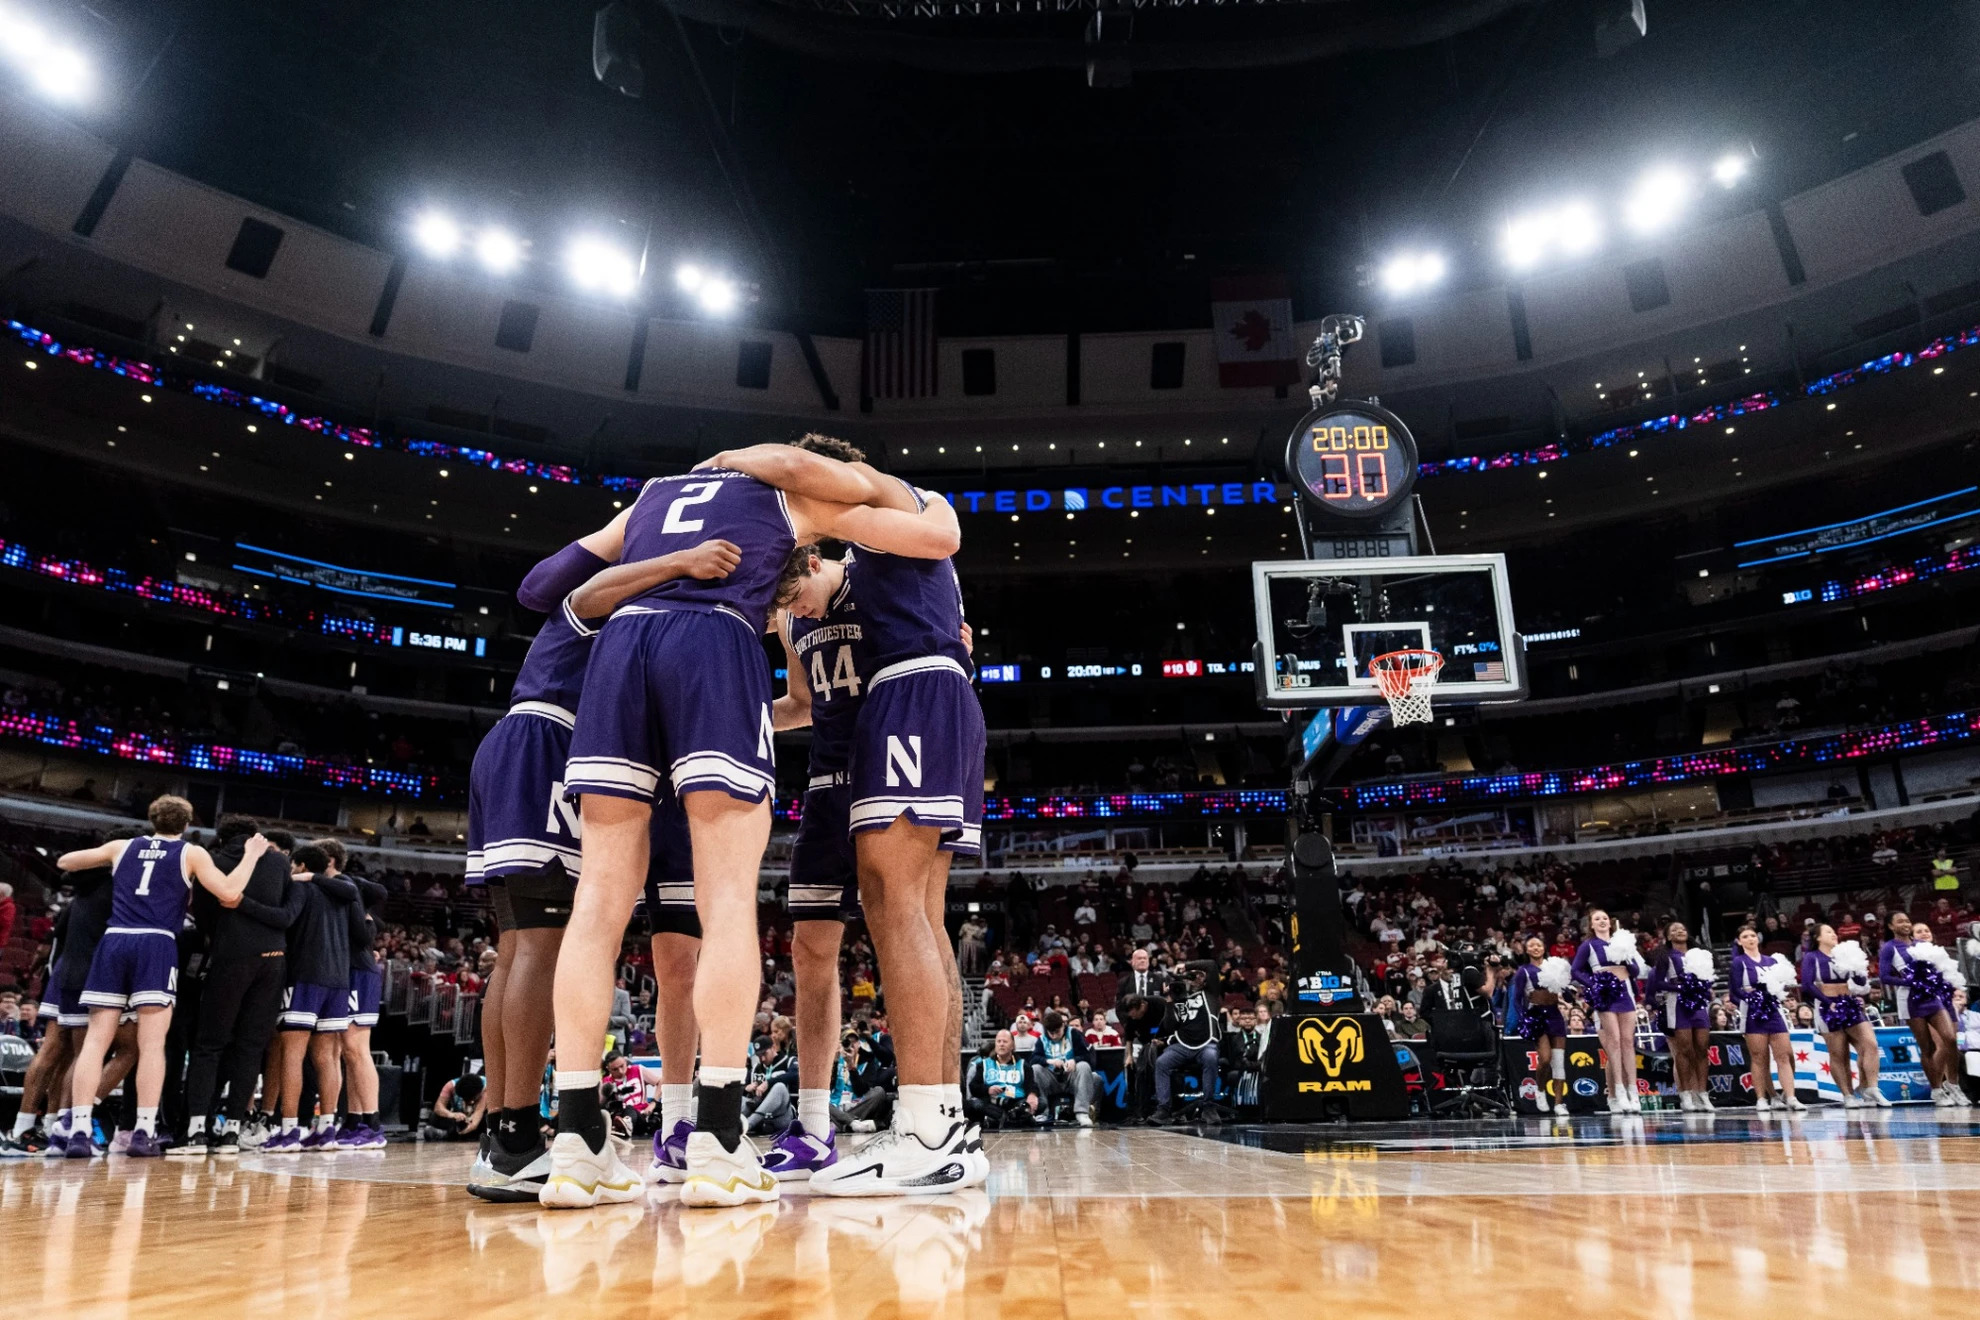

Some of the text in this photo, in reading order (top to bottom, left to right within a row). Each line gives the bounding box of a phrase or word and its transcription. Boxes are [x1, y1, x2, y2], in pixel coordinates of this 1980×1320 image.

[1312, 426, 1389, 451] 20:00
[1321, 453, 1388, 498] 30
[1102, 482, 1277, 509] CENTER
[661, 481, 723, 534] 2
[409, 632, 467, 651] 5:36 PM
[795, 624, 863, 656] NORTHWESTER
[811, 644, 862, 702] 44
[1002, 665, 1014, 681] N
[1041, 667, 1051, 679] 0
[1067, 665, 1101, 678] 20:00
[1131, 664, 1142, 676] 0
[1228, 662, 1237, 673] 4
[886, 735, 922, 788] N
[546, 781, 581, 839] N
[150, 840, 160, 849] N
[134, 861, 156, 896] 1
[167, 966, 179, 992] N
[1725, 1044, 1745, 1066] N
[1298, 1080, 1372, 1092] RAM
[1709, 1074, 1734, 1093] W
